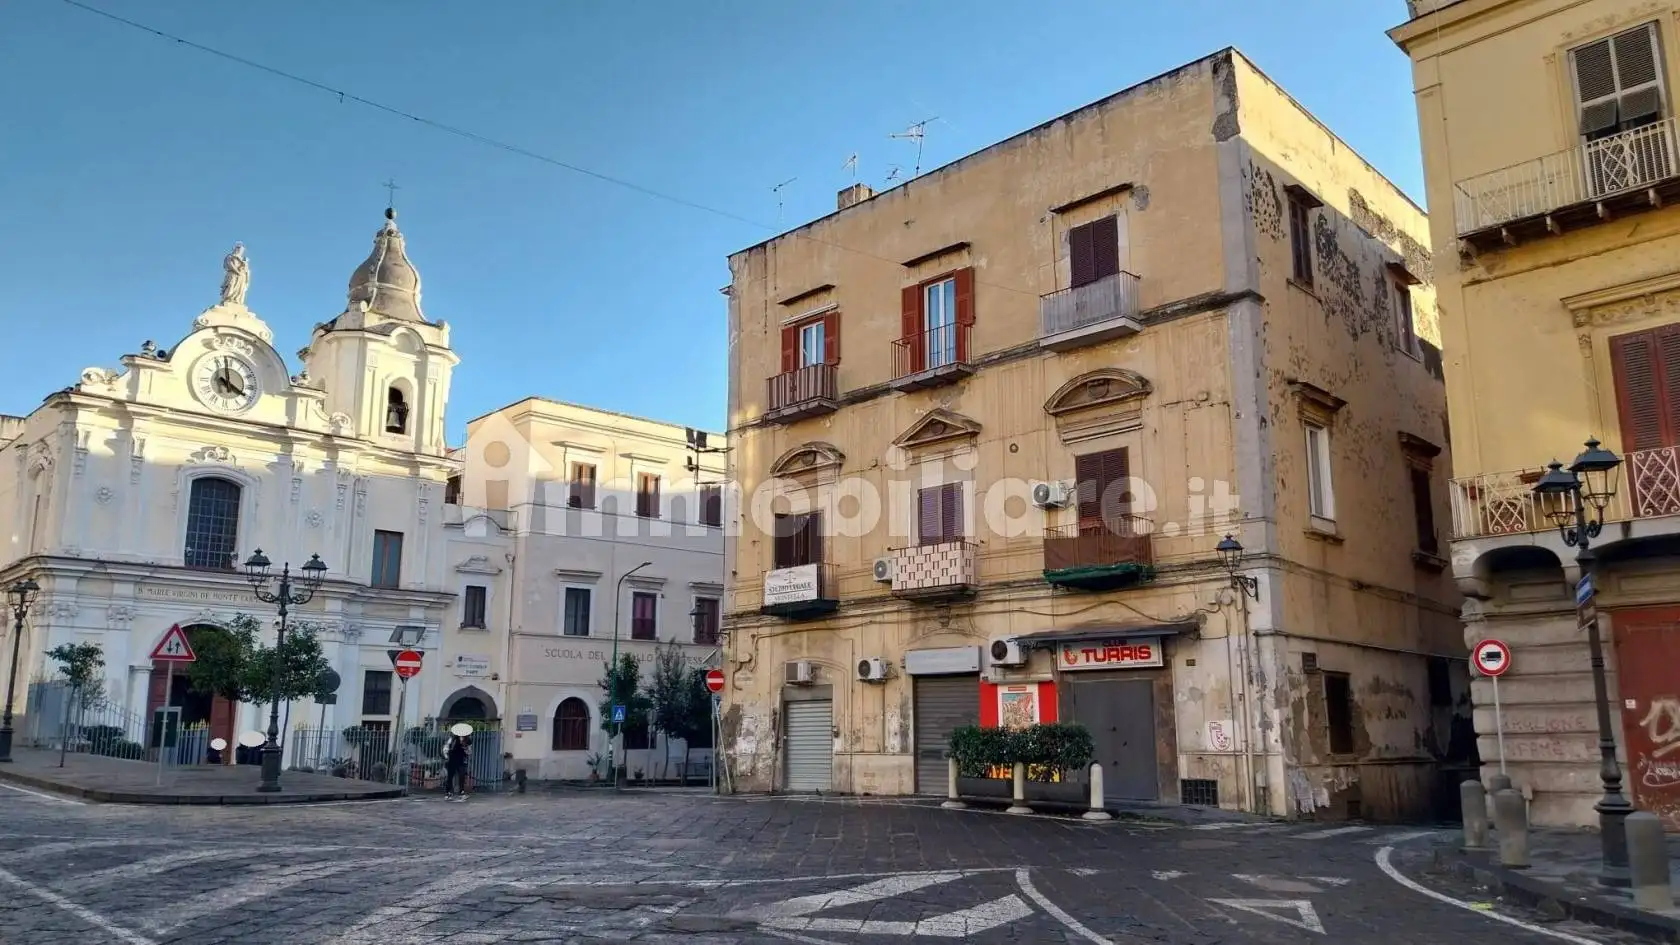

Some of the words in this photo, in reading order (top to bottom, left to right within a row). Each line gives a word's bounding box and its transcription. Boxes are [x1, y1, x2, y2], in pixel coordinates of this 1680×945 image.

[545, 648, 583, 659] SCUOLA
[588, 650, 606, 661] DEL
[1081, 645, 1152, 663] TURRIS
